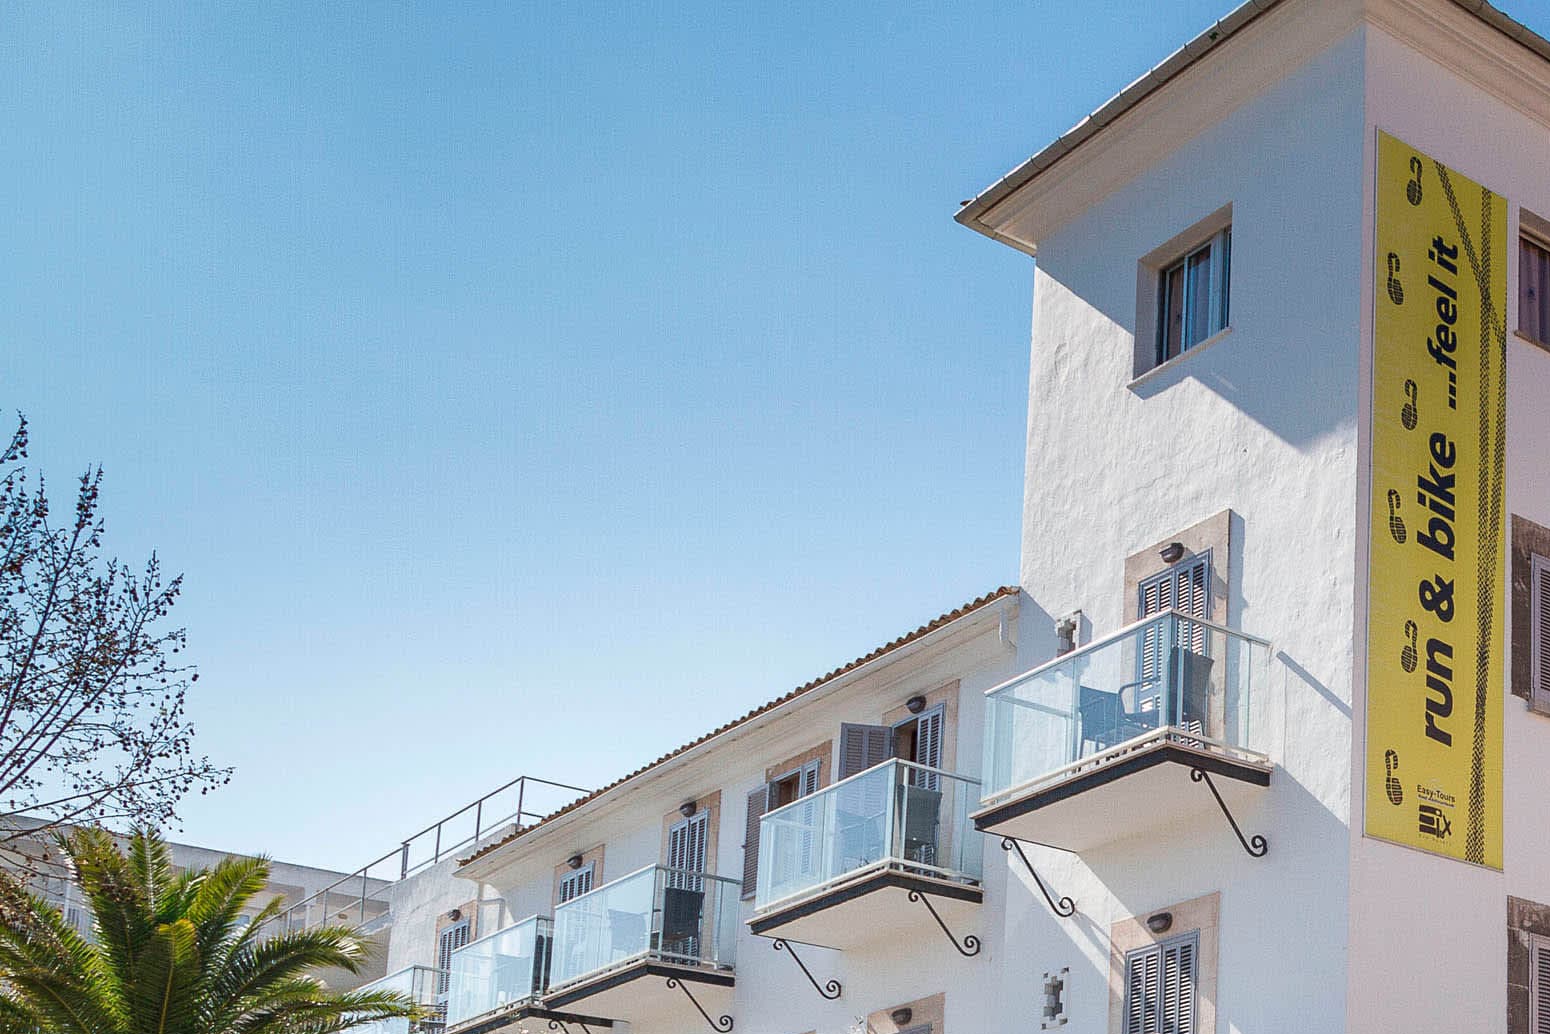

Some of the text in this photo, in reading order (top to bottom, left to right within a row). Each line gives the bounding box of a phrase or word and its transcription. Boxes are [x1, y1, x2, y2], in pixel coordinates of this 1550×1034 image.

[1428, 235, 1459, 277] it
[1417, 432, 1457, 562] bike
[1419, 574, 1455, 623] &
[1425, 638, 1453, 747] run
